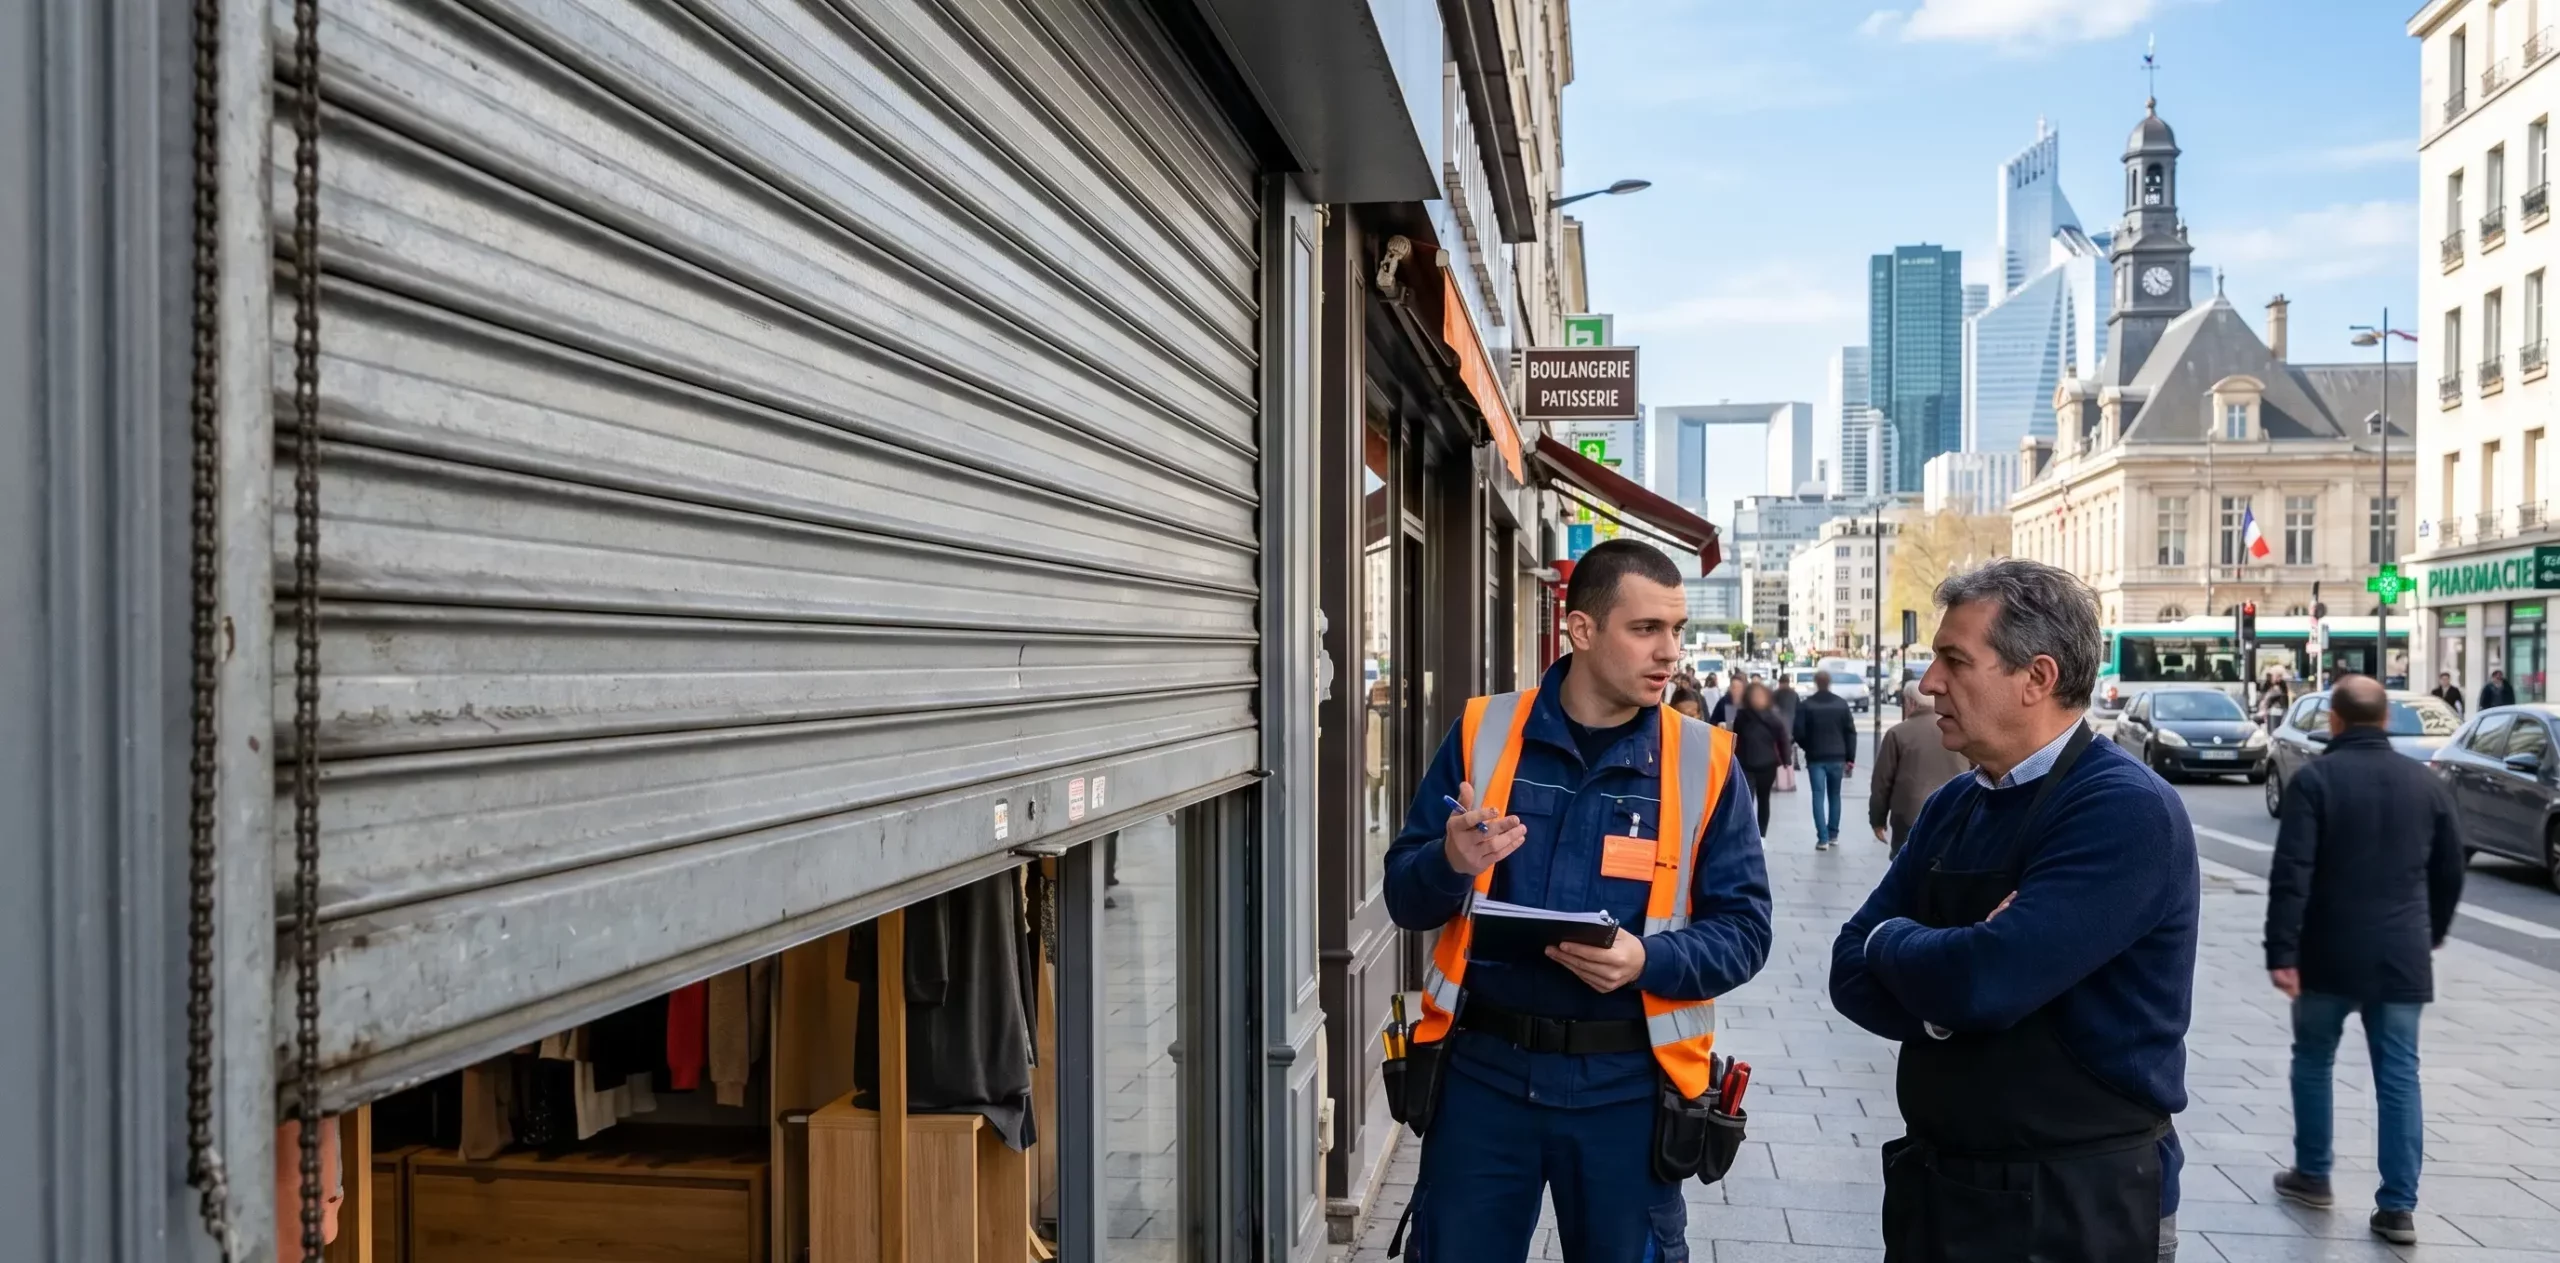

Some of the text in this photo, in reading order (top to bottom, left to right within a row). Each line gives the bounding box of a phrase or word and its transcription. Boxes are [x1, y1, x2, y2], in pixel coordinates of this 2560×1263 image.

[1530, 360, 1631, 379] BOULANGERIE
[1541, 389, 1619, 407] PATISSERIE
[2428, 556, 2534, 598] PHARMACIE
